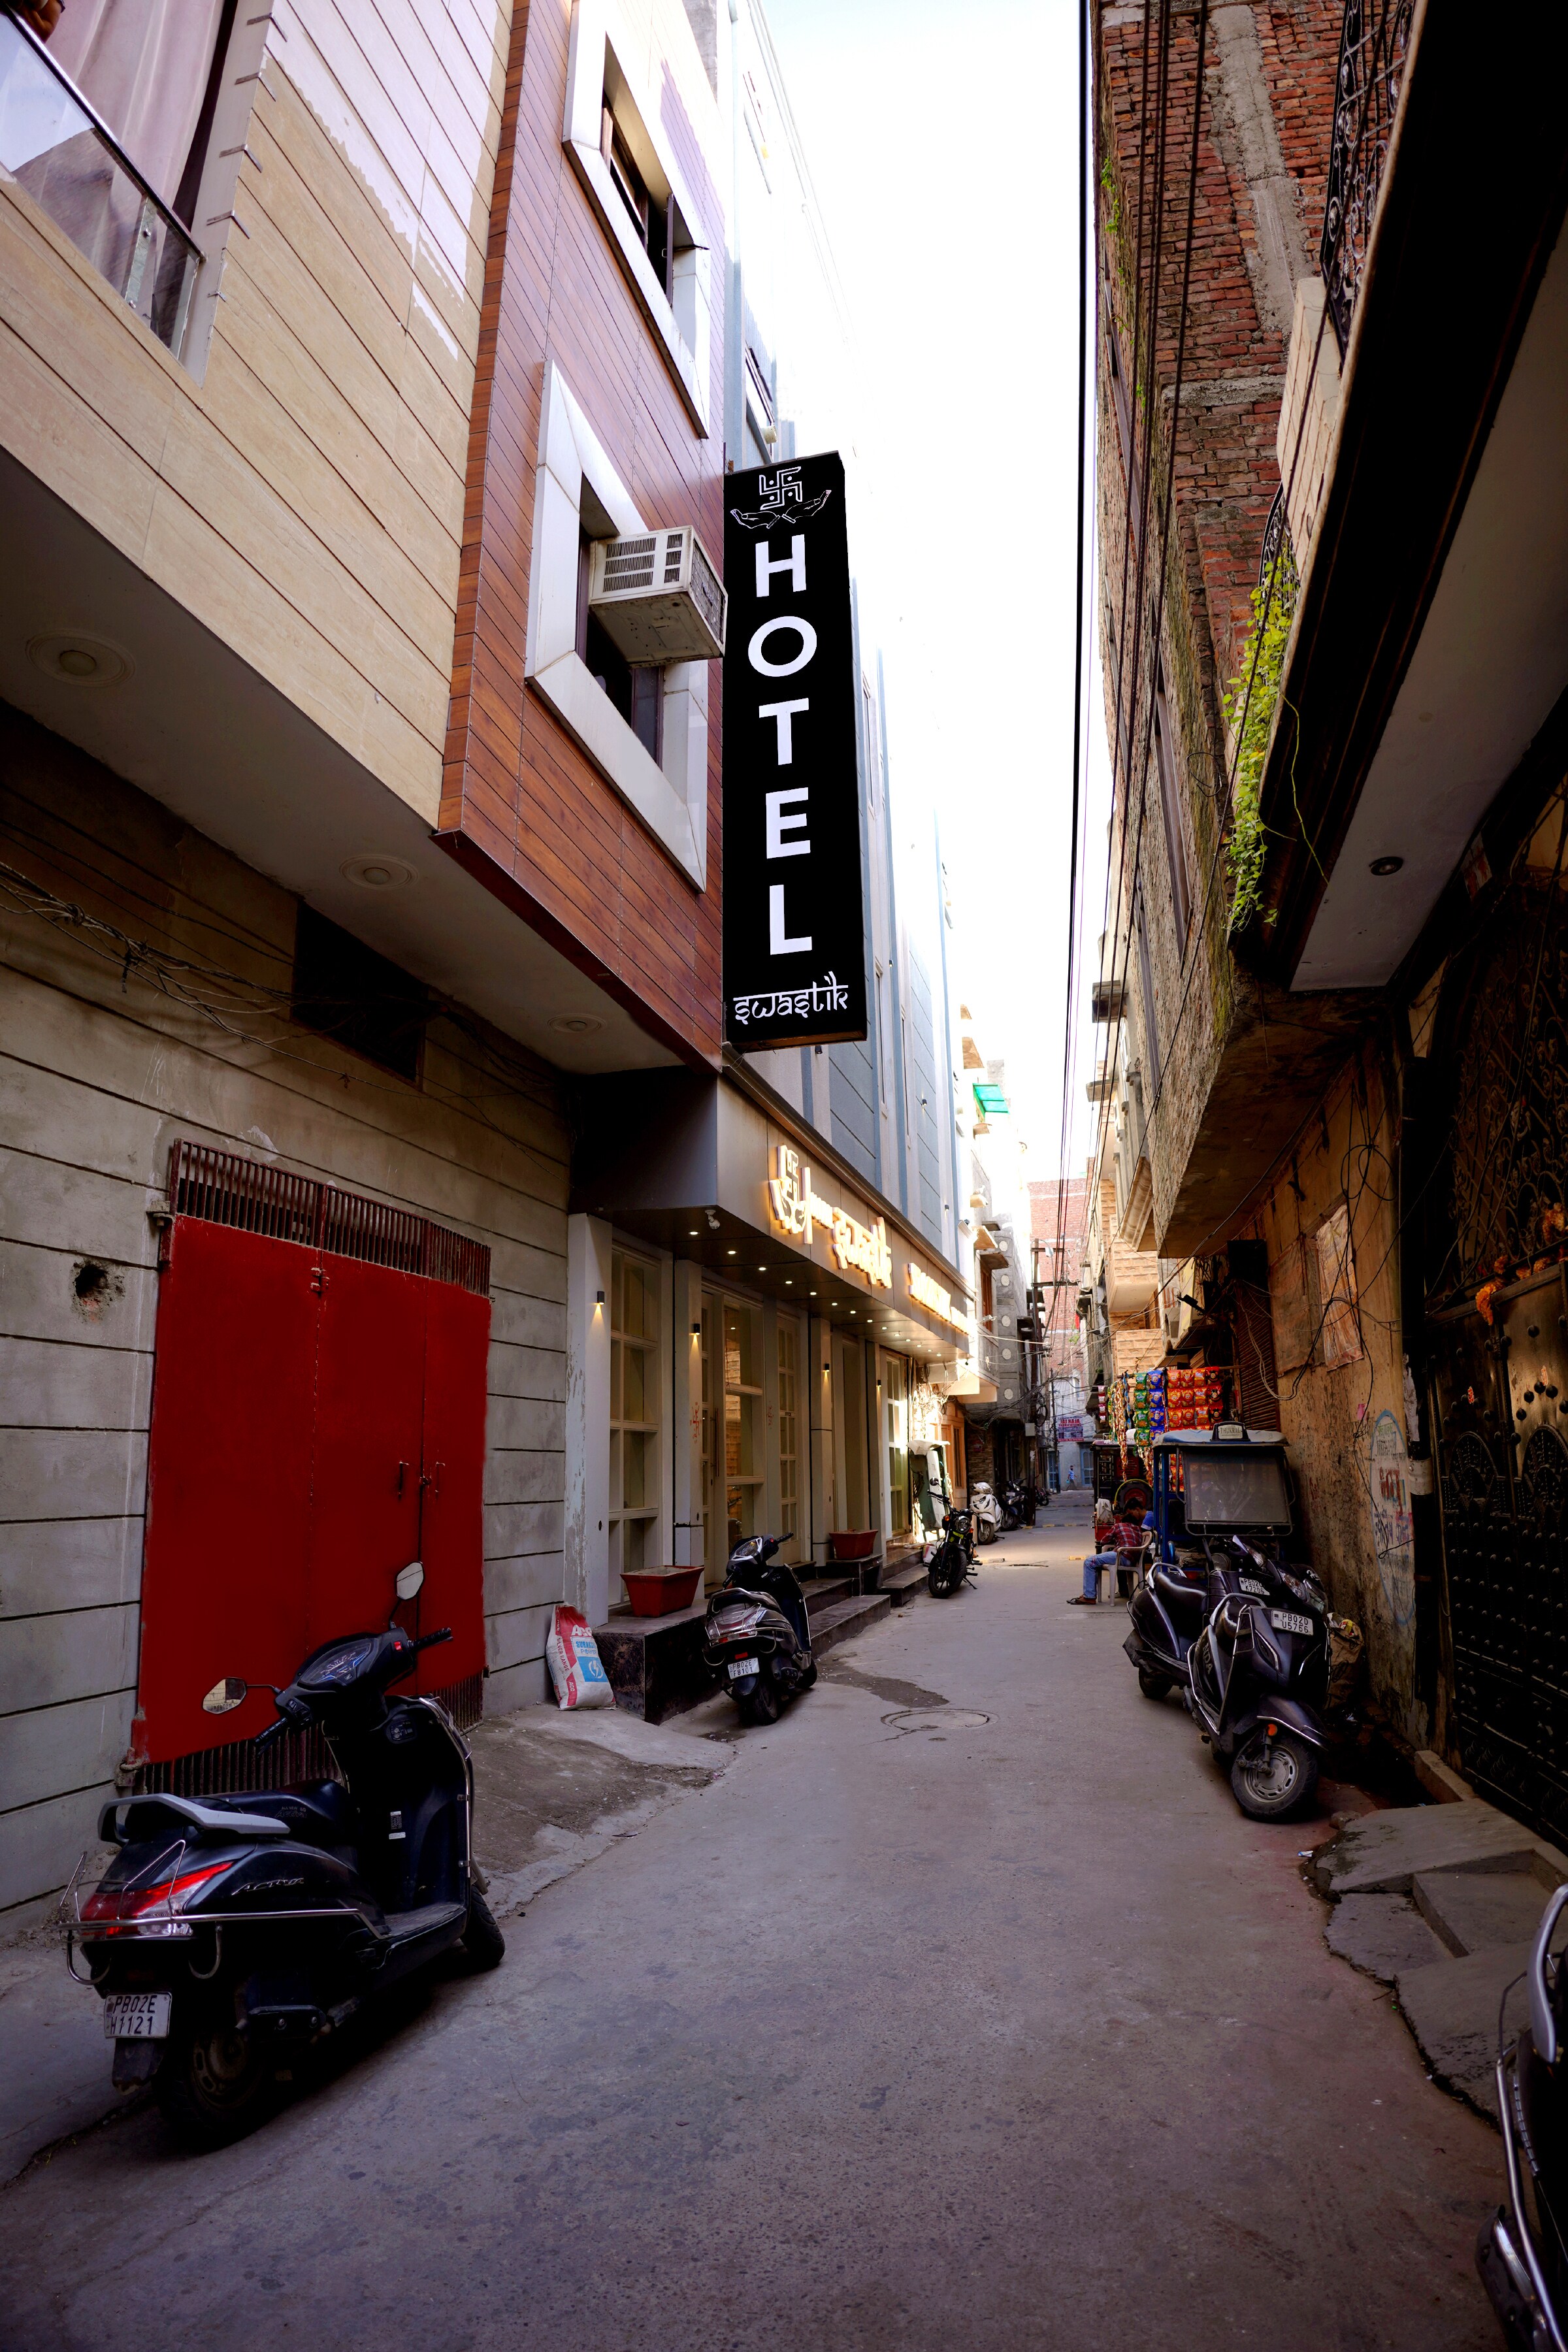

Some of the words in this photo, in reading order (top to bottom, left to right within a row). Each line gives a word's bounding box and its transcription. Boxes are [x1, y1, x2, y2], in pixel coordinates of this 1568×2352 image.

[747, 534, 818, 955] HOTEL
[733, 971, 849, 1025] swastik
[1282, 1613, 1309, 1625] PB02D
[1282, 1621, 1309, 1633] U5766
[560, 1655, 570, 1672] RANGE
[732, 1659, 753, 1671] PB02E
[733, 1667, 753, 1677] F8101
[113, 1995, 157, 2014] PB02E
[110, 2016, 153, 2034] H1121
